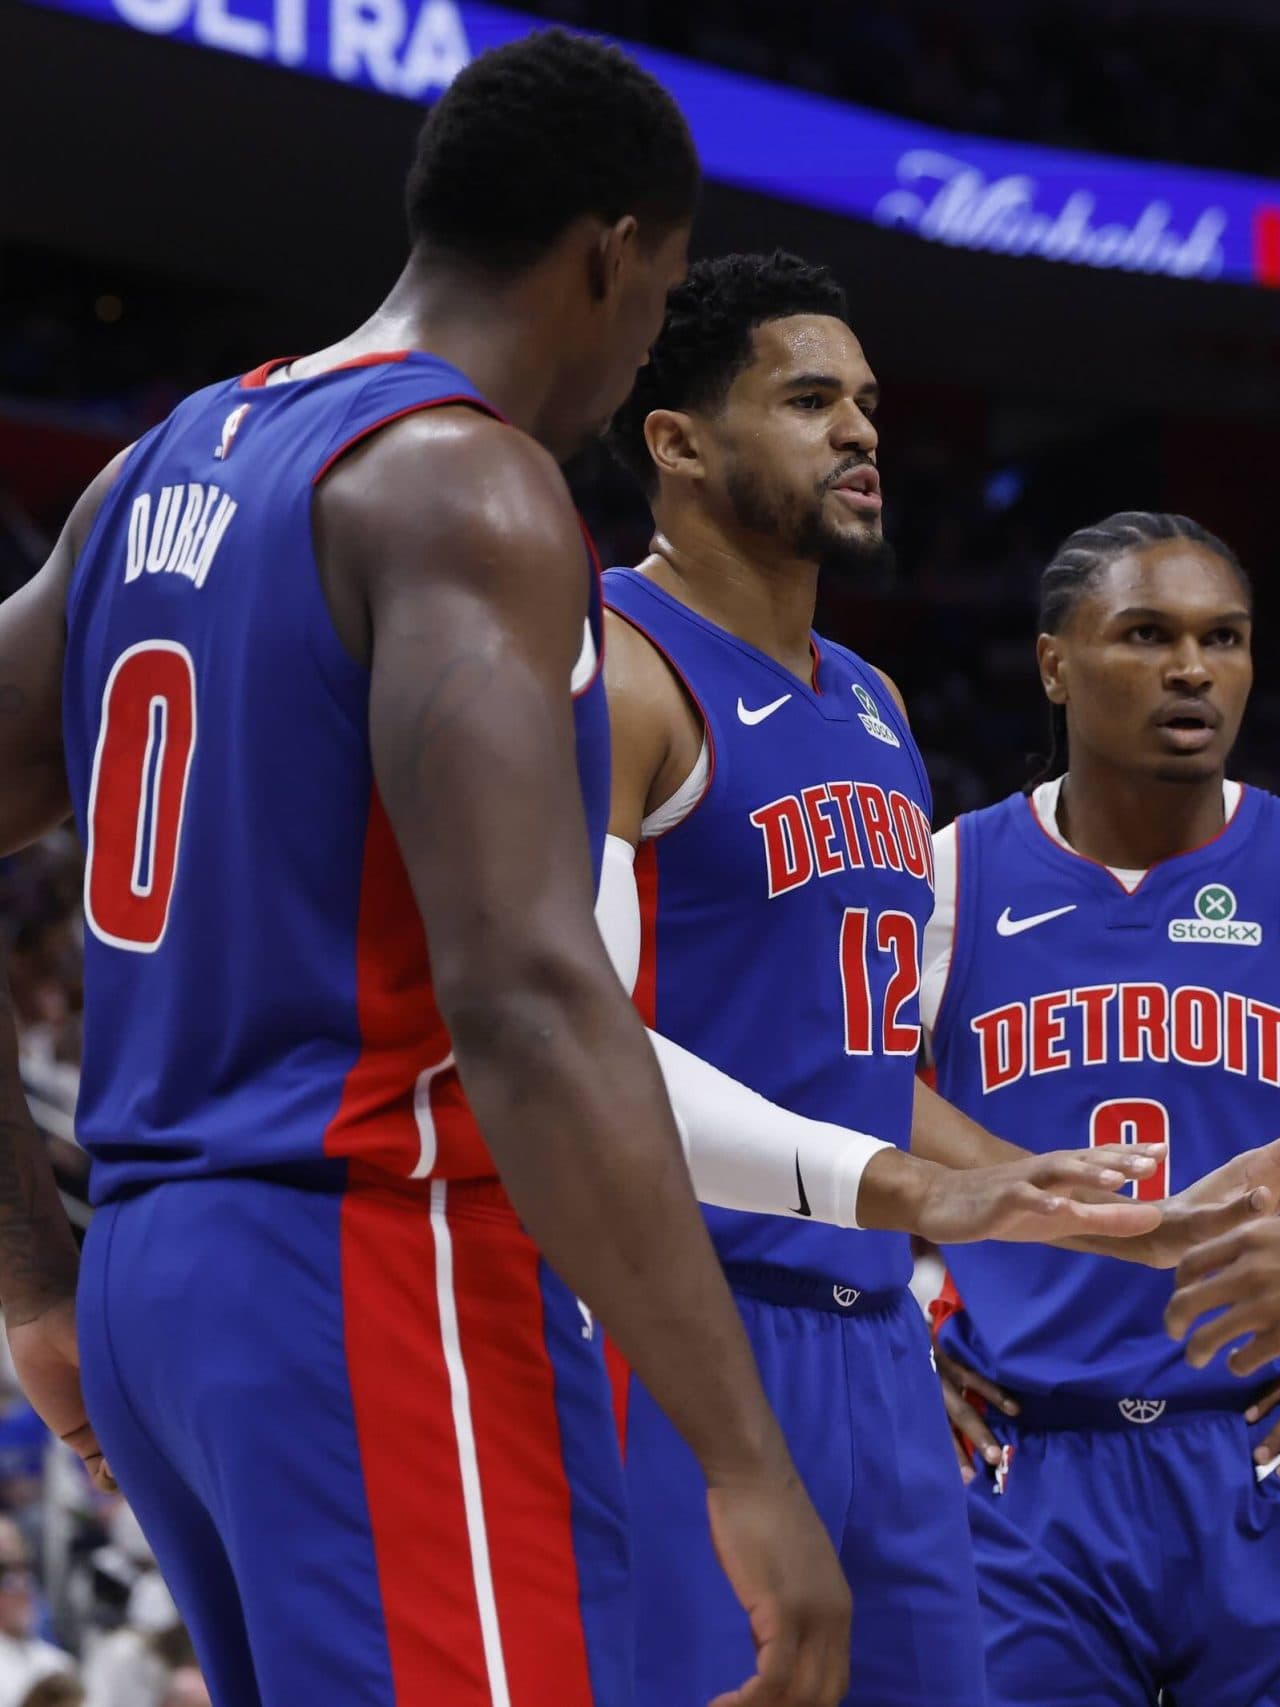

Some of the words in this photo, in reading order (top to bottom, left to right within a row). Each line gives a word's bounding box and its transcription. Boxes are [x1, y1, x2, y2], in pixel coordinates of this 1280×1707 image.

[124, 483, 238, 590] DUREN
[84, 639, 197, 953] 0
[750, 781, 935, 899] DETROI
[839, 908, 921, 1057] 12
[1172, 923, 1258, 942] StockX
